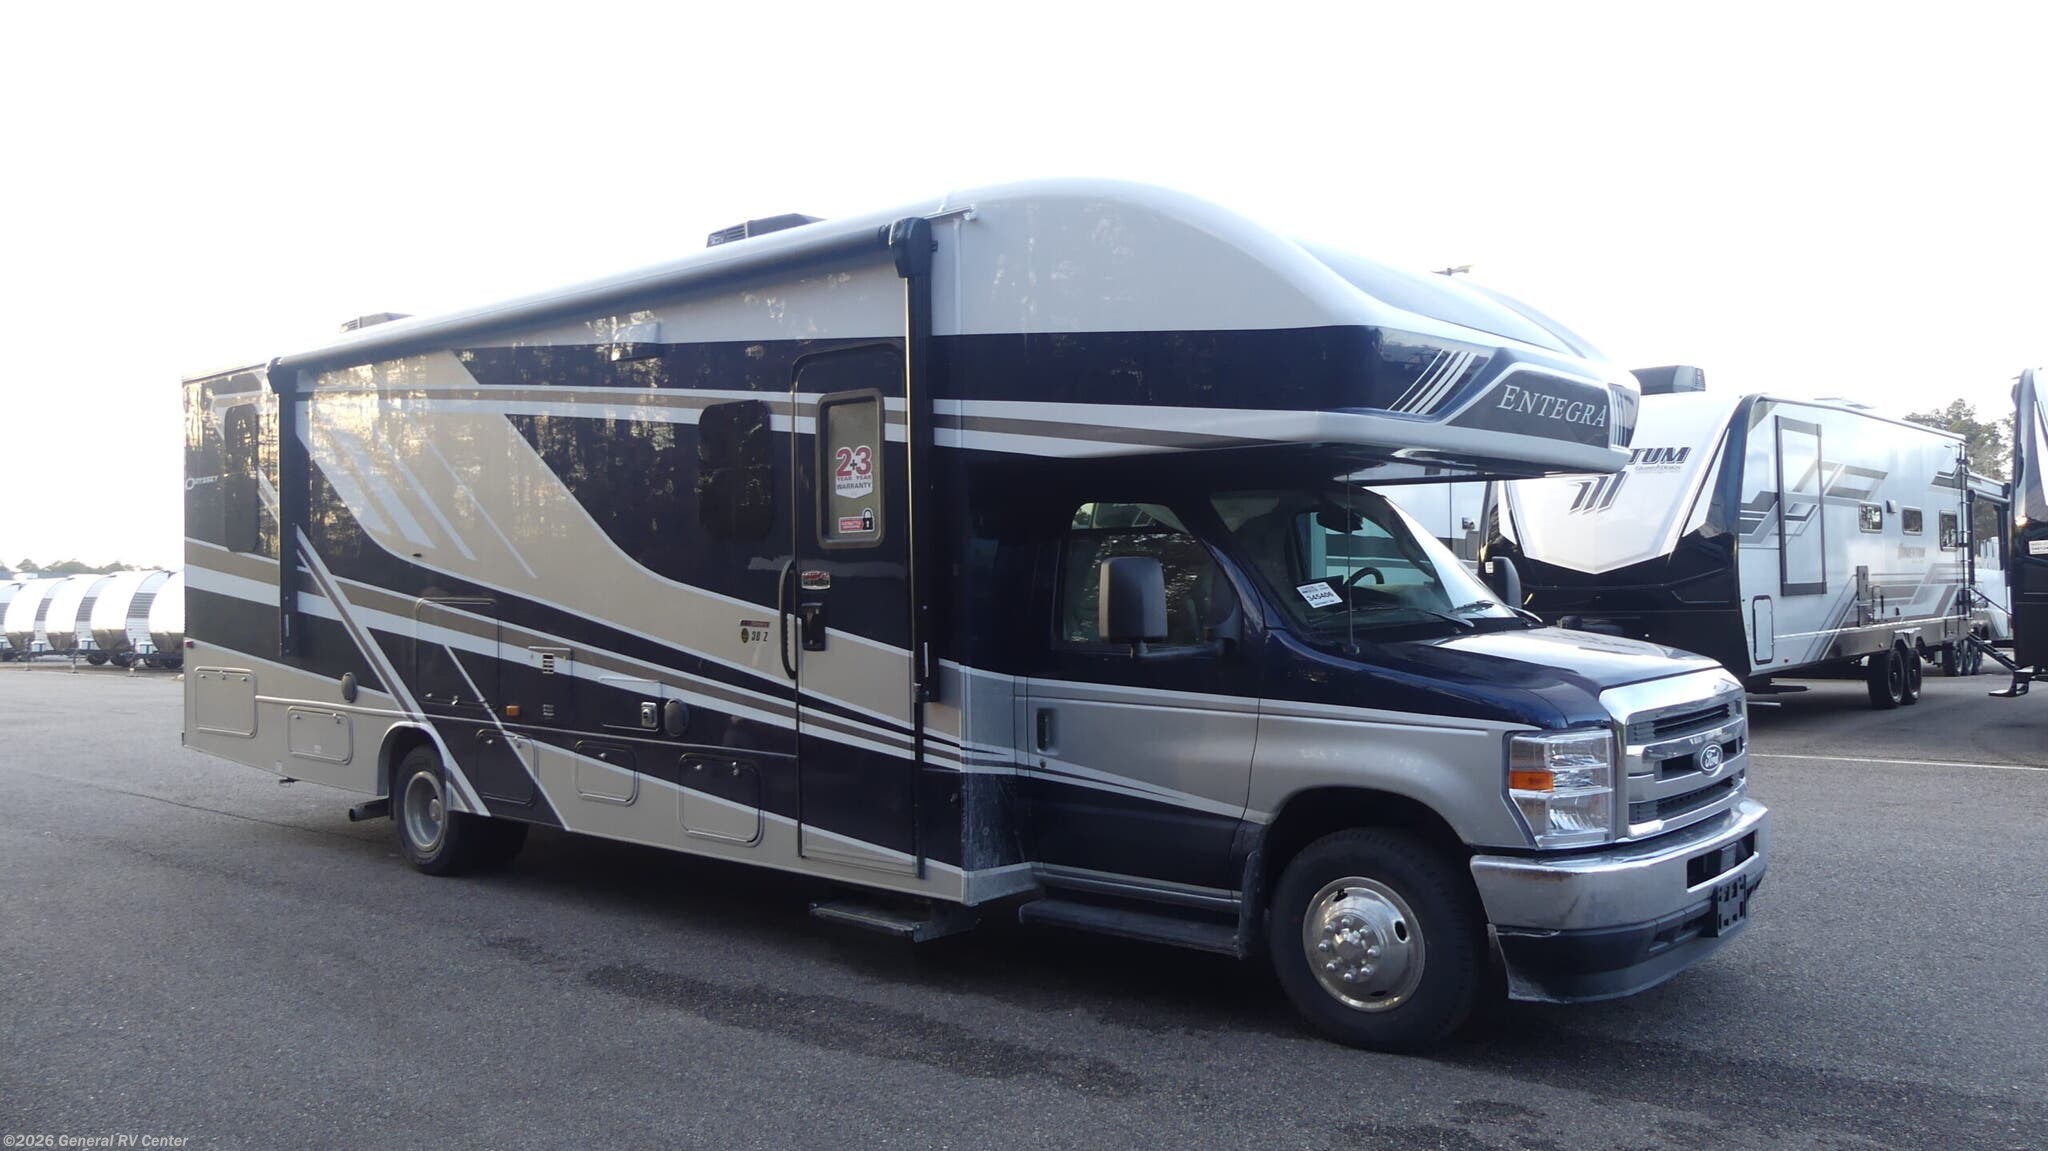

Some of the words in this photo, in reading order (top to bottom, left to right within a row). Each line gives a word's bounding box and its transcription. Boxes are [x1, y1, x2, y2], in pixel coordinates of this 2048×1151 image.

[1496, 384, 1608, 427] ENTEGRA
[837, 482, 871, 490] WARRANTY
[1704, 748, 1720, 768] Ford
